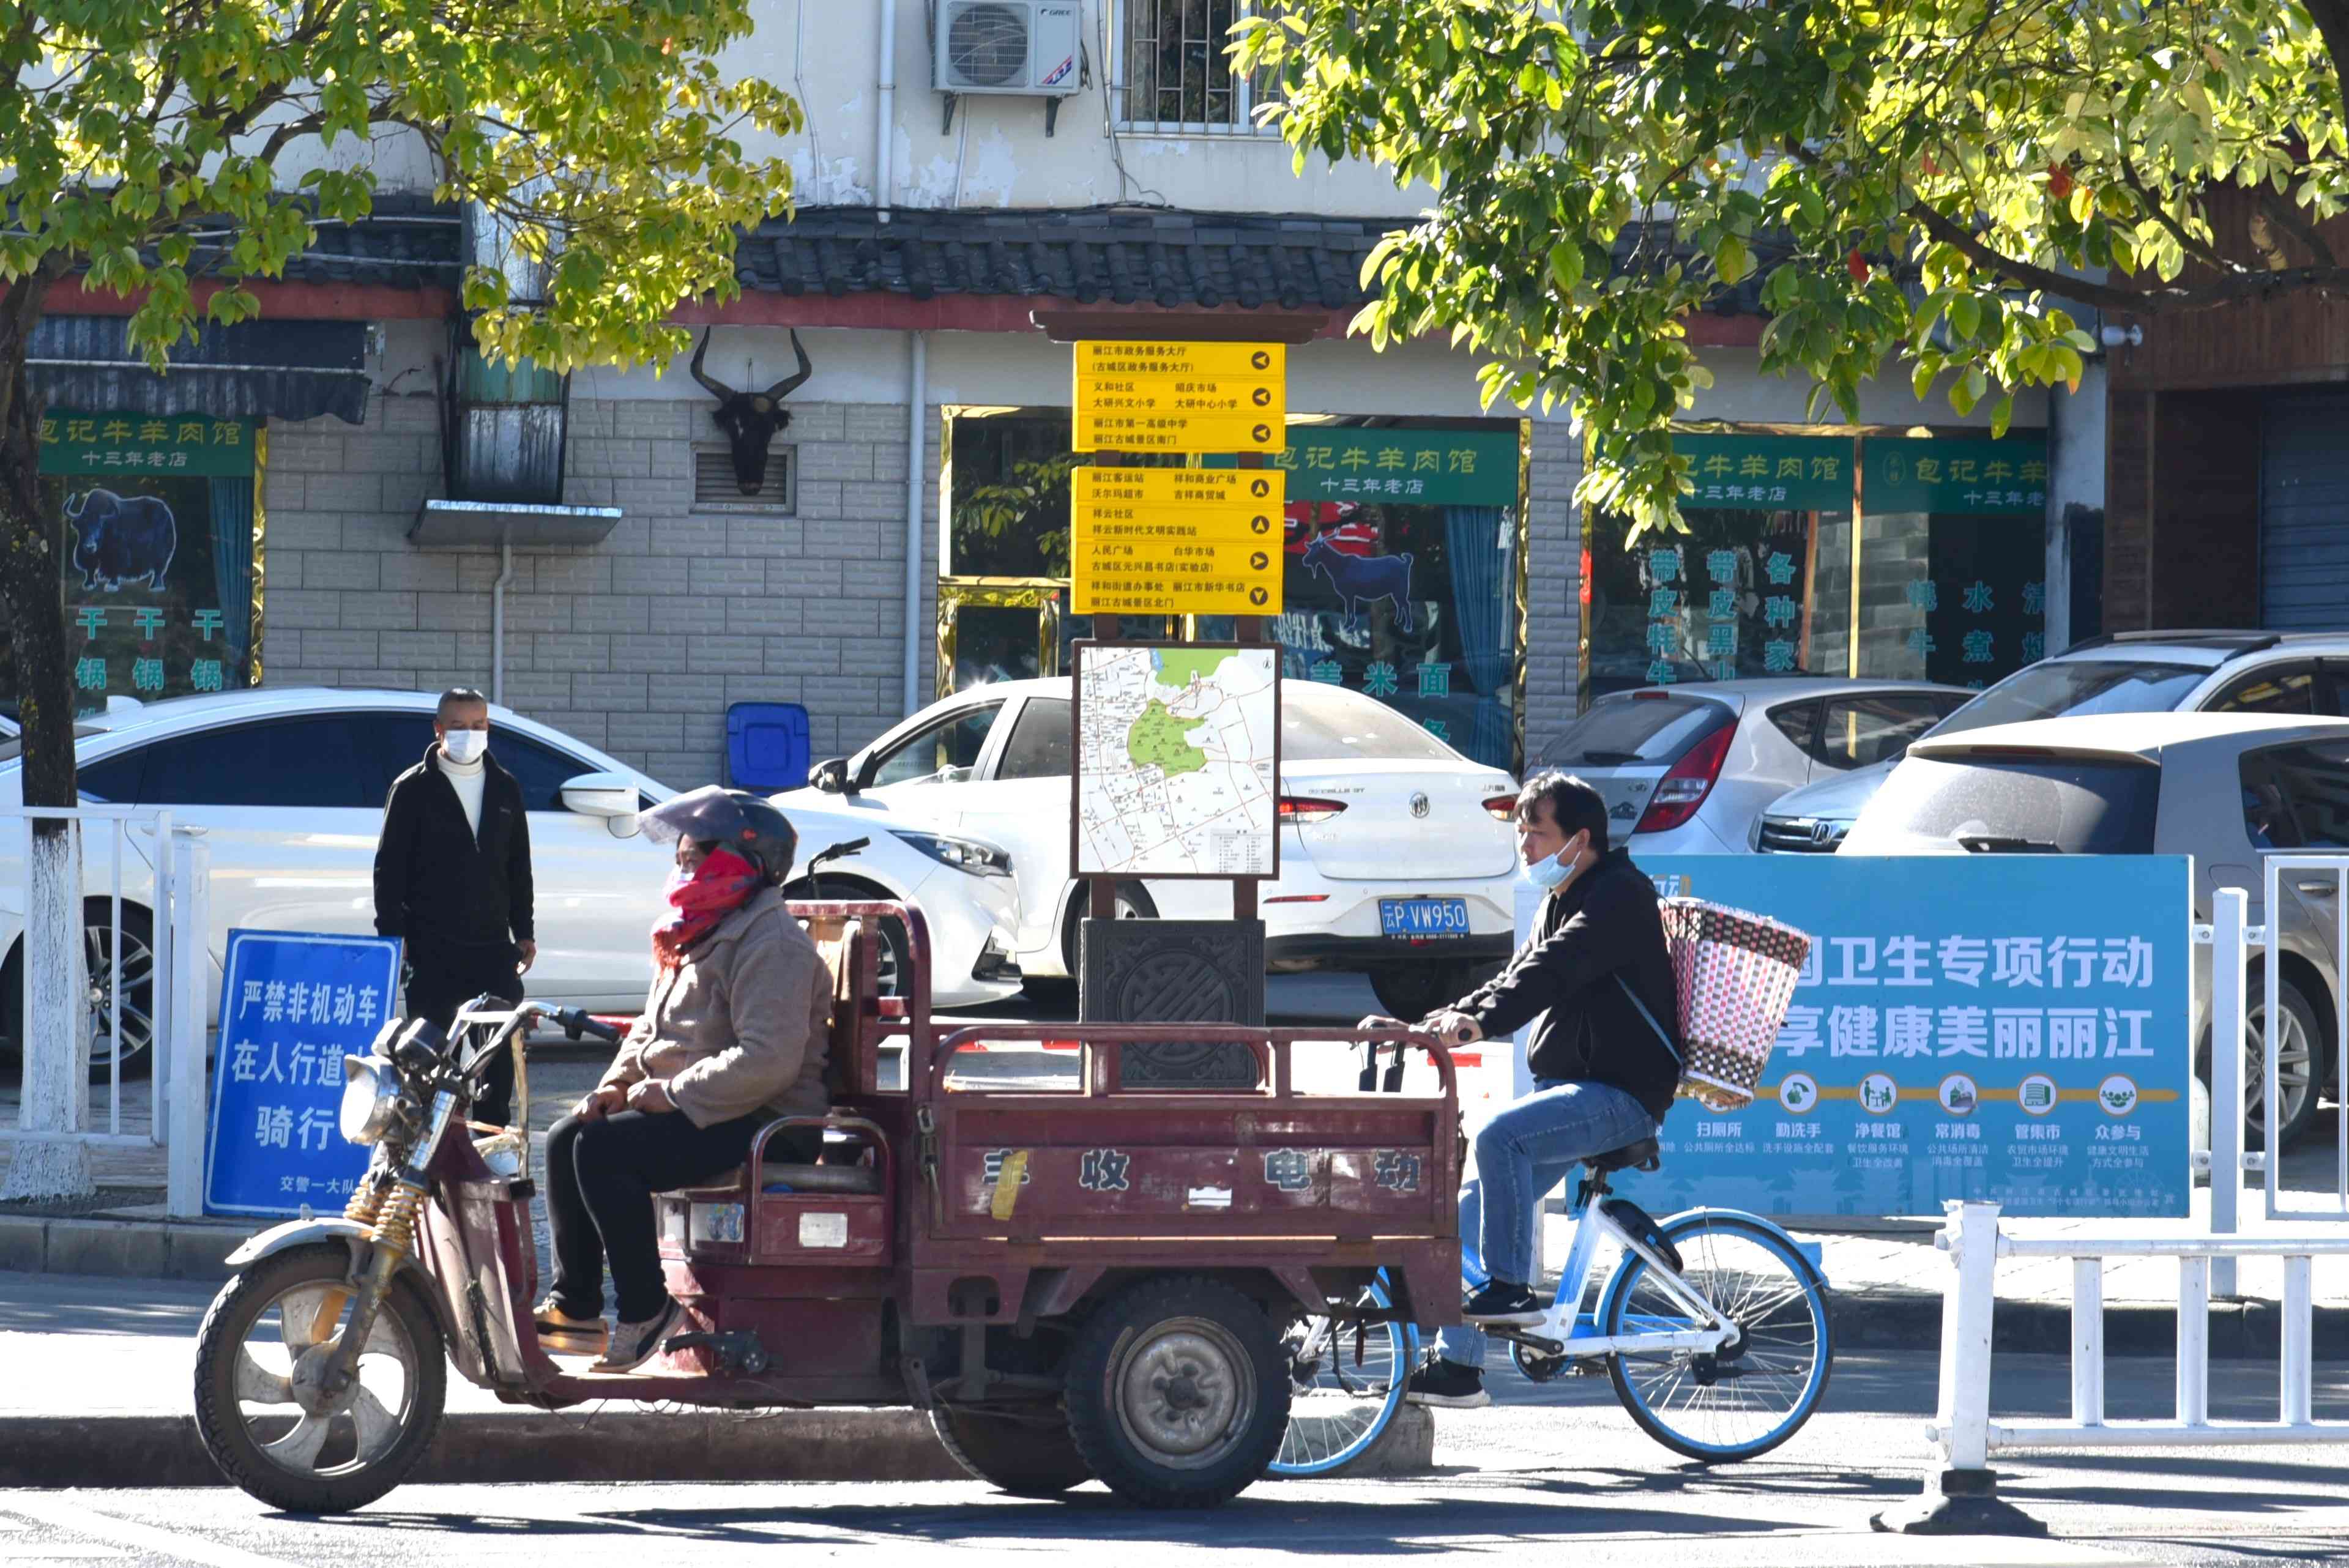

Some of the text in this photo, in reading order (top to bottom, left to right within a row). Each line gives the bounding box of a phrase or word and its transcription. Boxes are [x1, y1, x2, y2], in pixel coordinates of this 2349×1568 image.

[1093, 346, 1186, 357] 丽江市政务服务大厅
[1094, 382, 1134, 392] 义和社区
[1175, 382, 1216, 393] 昭庆市场
[1093, 398, 1155, 409] 大研兴文小学
[1175, 399, 1237, 409] 大研中心小学
[1093, 418, 1187, 429] 丽江市第一高级中学
[1093, 434, 1177, 445] 丽江古城景区南门
[82, 450, 187, 467] 十三年老店
[1092, 472, 1144, 483] 丽江客运站
[1174, 474, 1237, 485] 祥和商业广场
[1320, 477, 1424, 494] 十三年老店
[1092, 489, 1144, 499] 沃尔玛超市
[1174, 490, 1226, 500] 吉祥商贸城
[1093, 508, 1134, 519] 祥云社区
[1093, 525, 1197, 537] 祥云新时代文明实践站
[1092, 545, 1133, 556] 人民广场
[1174, 546, 1215, 557] 白华市场
[1092, 582, 1164, 592] 祥和街道办事处
[1173, 582, 1245, 593] 丽江市新华书店
[1091, 597, 1174, 608] 丽江古城景区北门
[239, 980, 379, 1027] 严禁非机动车
[1773, 1005, 2154, 1059] 享健康美丽丽江
[255, 1105, 335, 1151] 骑行
[1696, 1121, 1742, 1138] 扫厕所
[1775, 1122, 1822, 1139] 勤洗手
[1855, 1122, 1901, 1139] 净餐馆
[1935, 1123, 1981, 1139] 常消毒
[2015, 1124, 2061, 1140] 管集市
[2094, 1124, 2141, 1141] 众参与
[1684, 1142, 1755, 1154] 公共厕所全达标
[280, 1176, 355, 1195] 交警一大队
